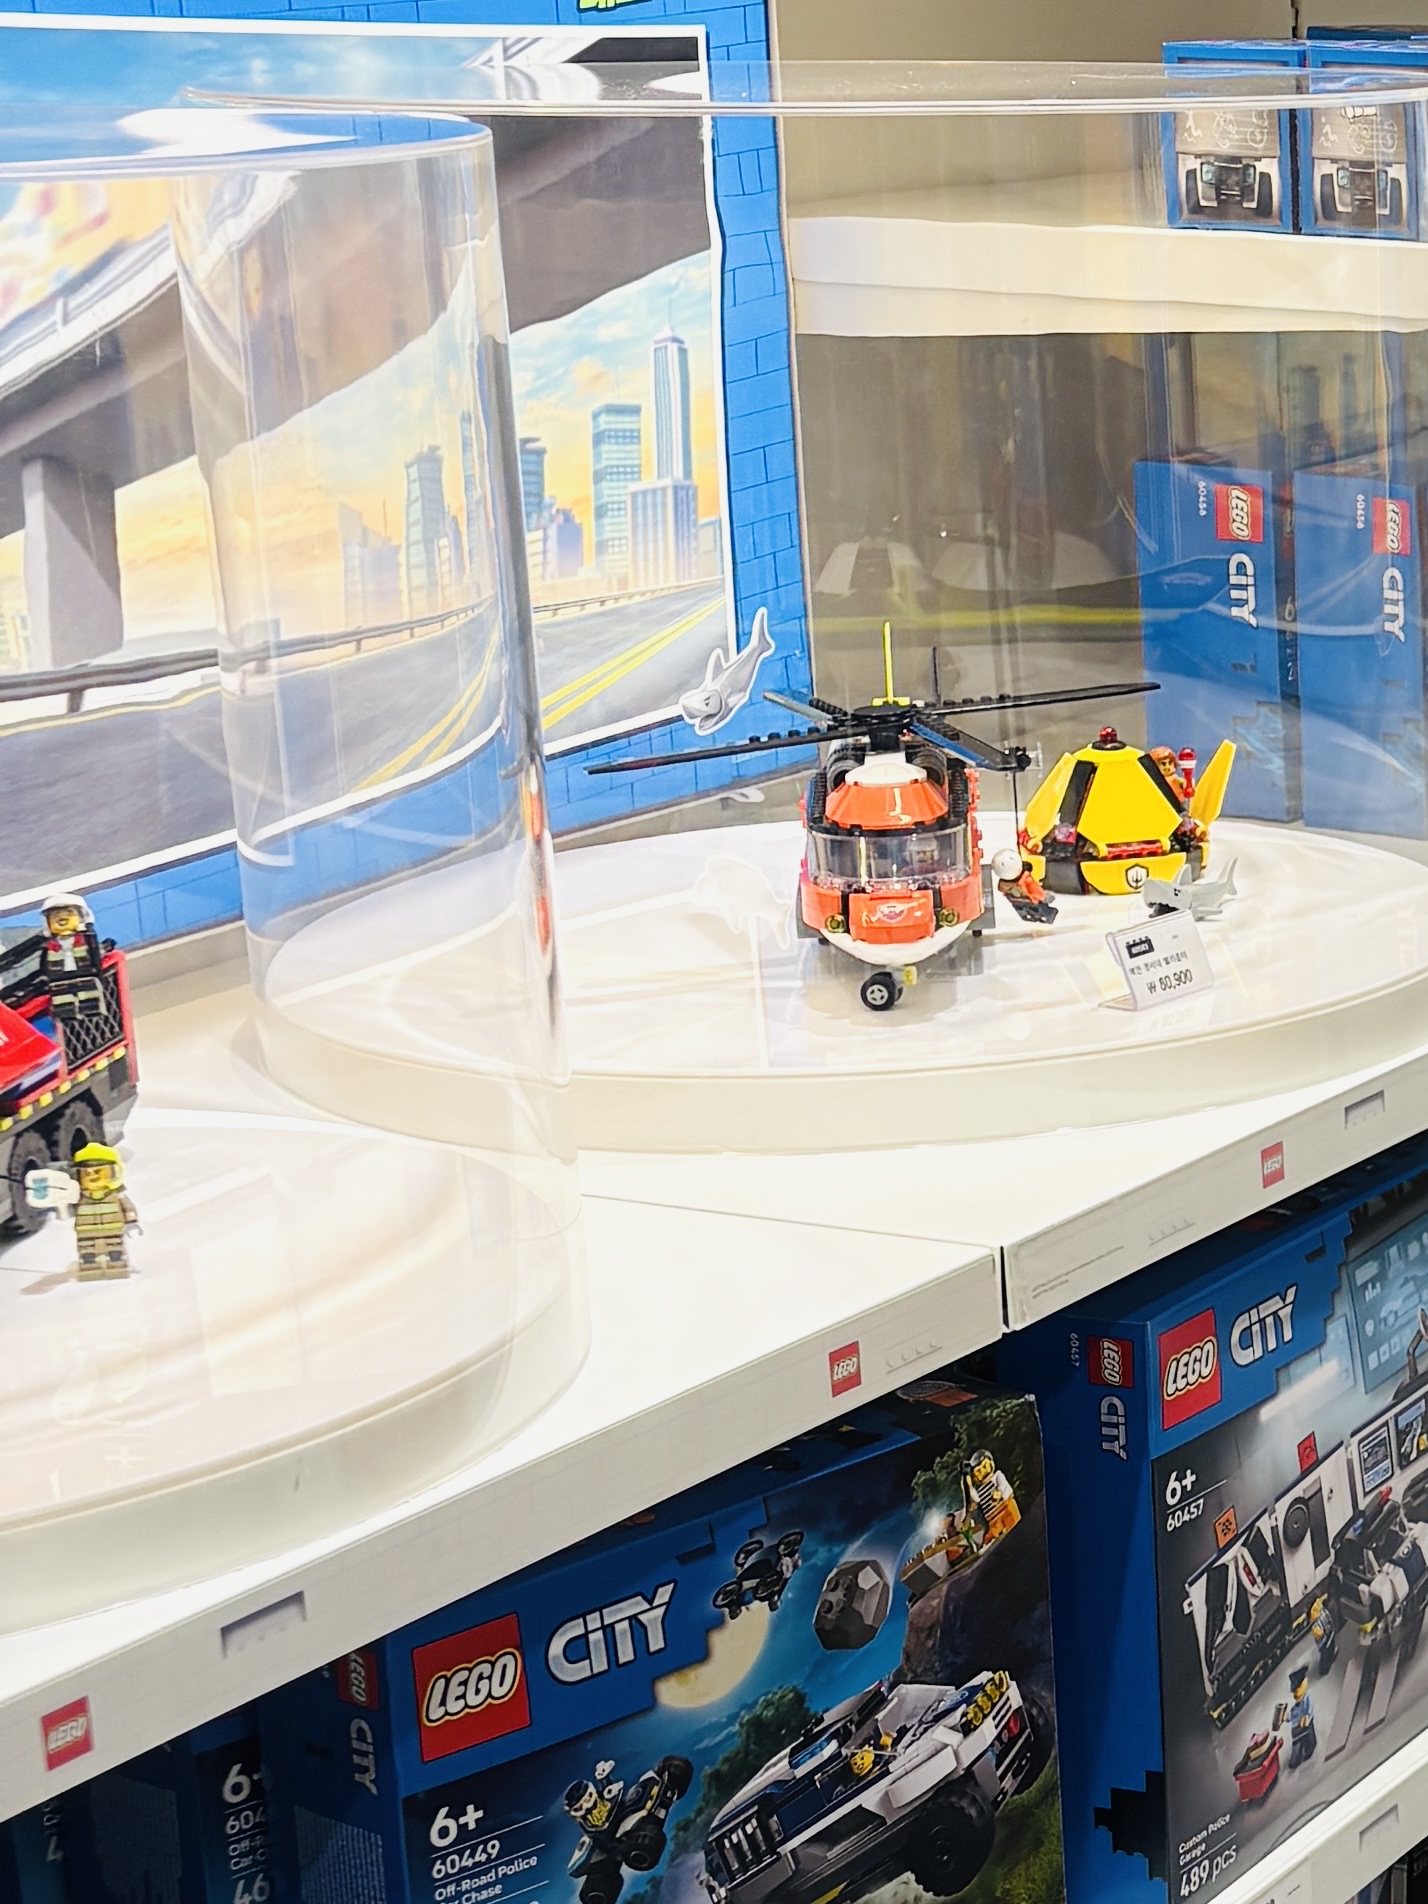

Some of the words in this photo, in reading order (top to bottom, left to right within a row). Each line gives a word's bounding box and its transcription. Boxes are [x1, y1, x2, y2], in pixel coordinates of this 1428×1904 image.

[1228, 486, 1250, 540] LEGO
[1387, 502, 1400, 552] LEGO
[1263, 1157, 1282, 1173] LEGO
[1100, 1339, 1121, 1385] LEGO
[1164, 1338, 1217, 1399] LEGO
[1166, 1470, 1197, 1506] 6+
[1166, 1499, 1205, 1533] 60457
[423, 1649, 520, 1727] LEGO
[46, 1717, 88, 1753] LEGO
[430, 1804, 485, 1847] 6+
[1179, 1829, 1207, 1853] Custom
[1208, 1814, 1230, 1835] Police
[431, 1840, 500, 1879] 60449
[434, 1868, 496, 1900] Off-Road
[499, 1855, 538, 1877] Police
[1180, 1860, 1209, 1897] 489
[1212, 1845, 1236, 1882] pcs
